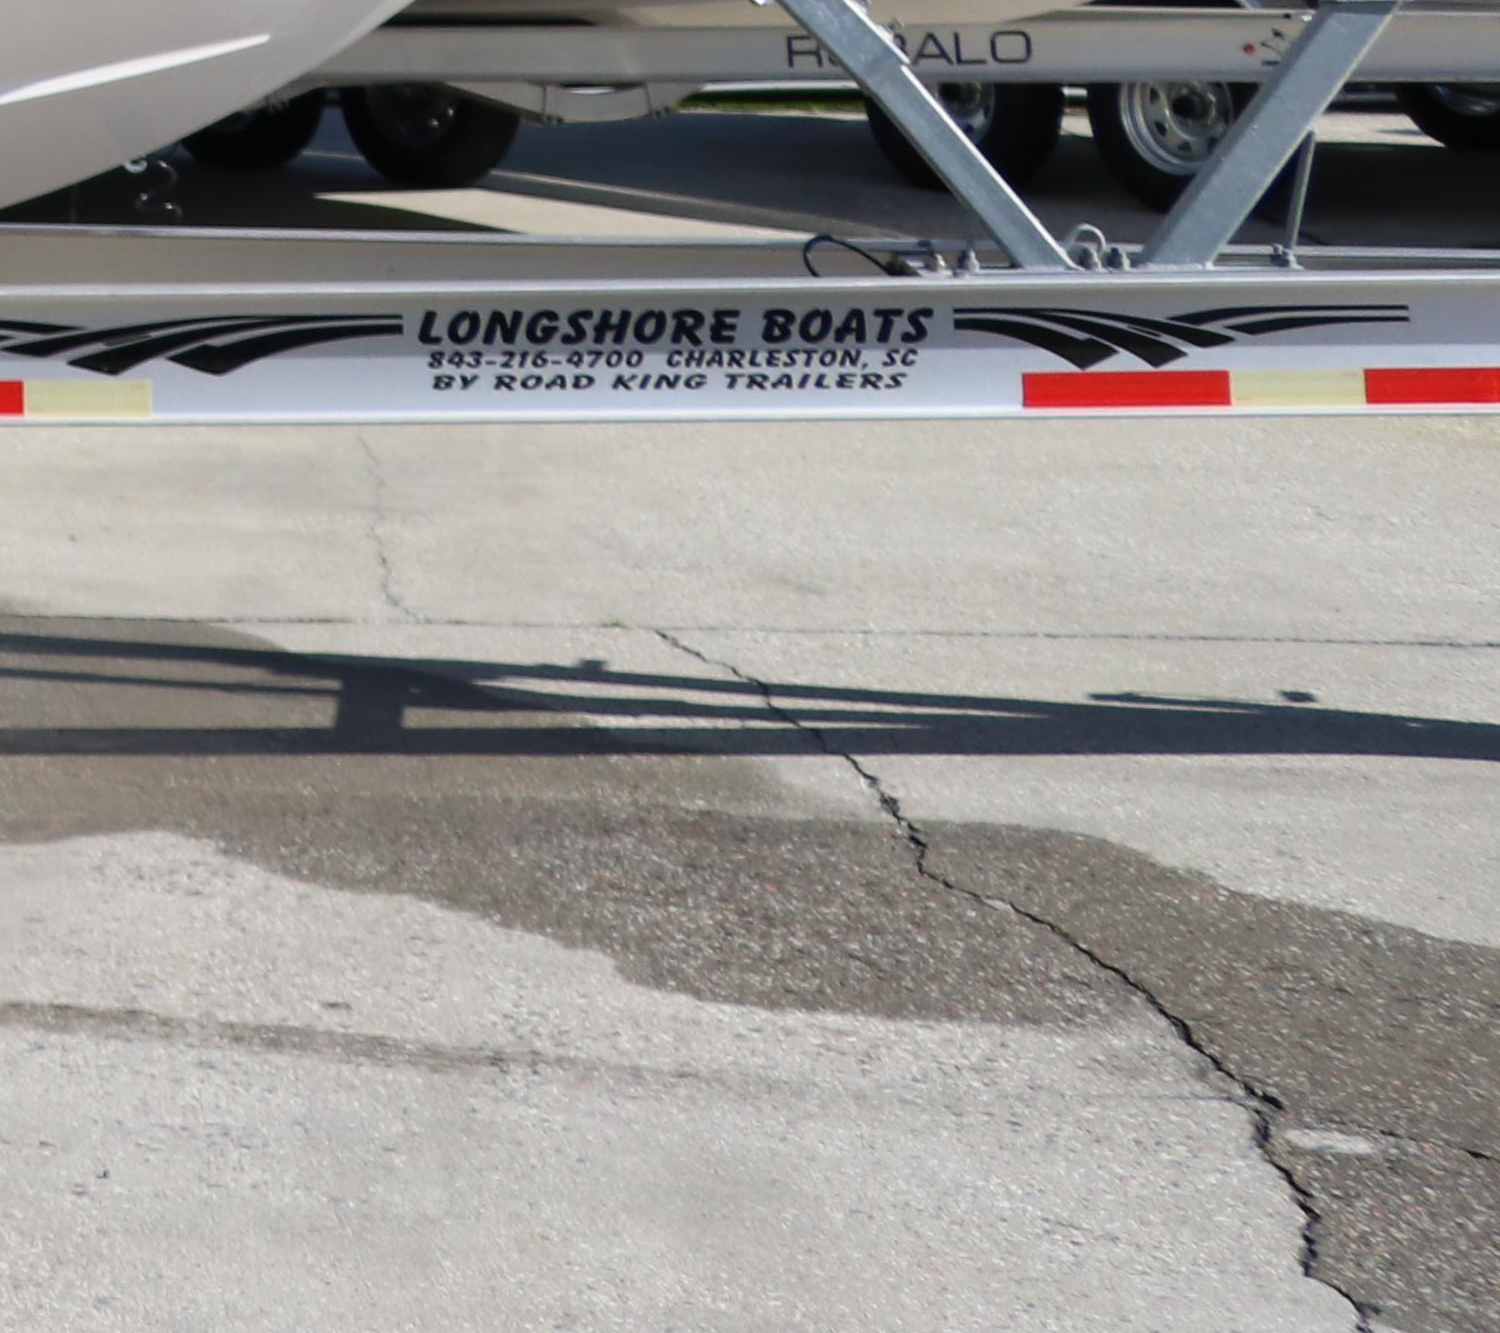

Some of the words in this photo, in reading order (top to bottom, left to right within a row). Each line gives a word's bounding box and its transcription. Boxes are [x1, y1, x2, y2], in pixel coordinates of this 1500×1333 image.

[786, 30, 1033, 67] RALO
[418, 309, 741, 346] LONGSHORE
[762, 308, 935, 345] BOATS
[428, 350, 644, 369] 843-216-4700
[666, 349, 869, 369] CHARLESTON,
[882, 348, 919, 368] SC
[432, 374, 479, 390] BY
[494, 374, 596, 391] ROAD
[612, 374, 708, 391] KING
[724, 373, 908, 390] TRAILERS
